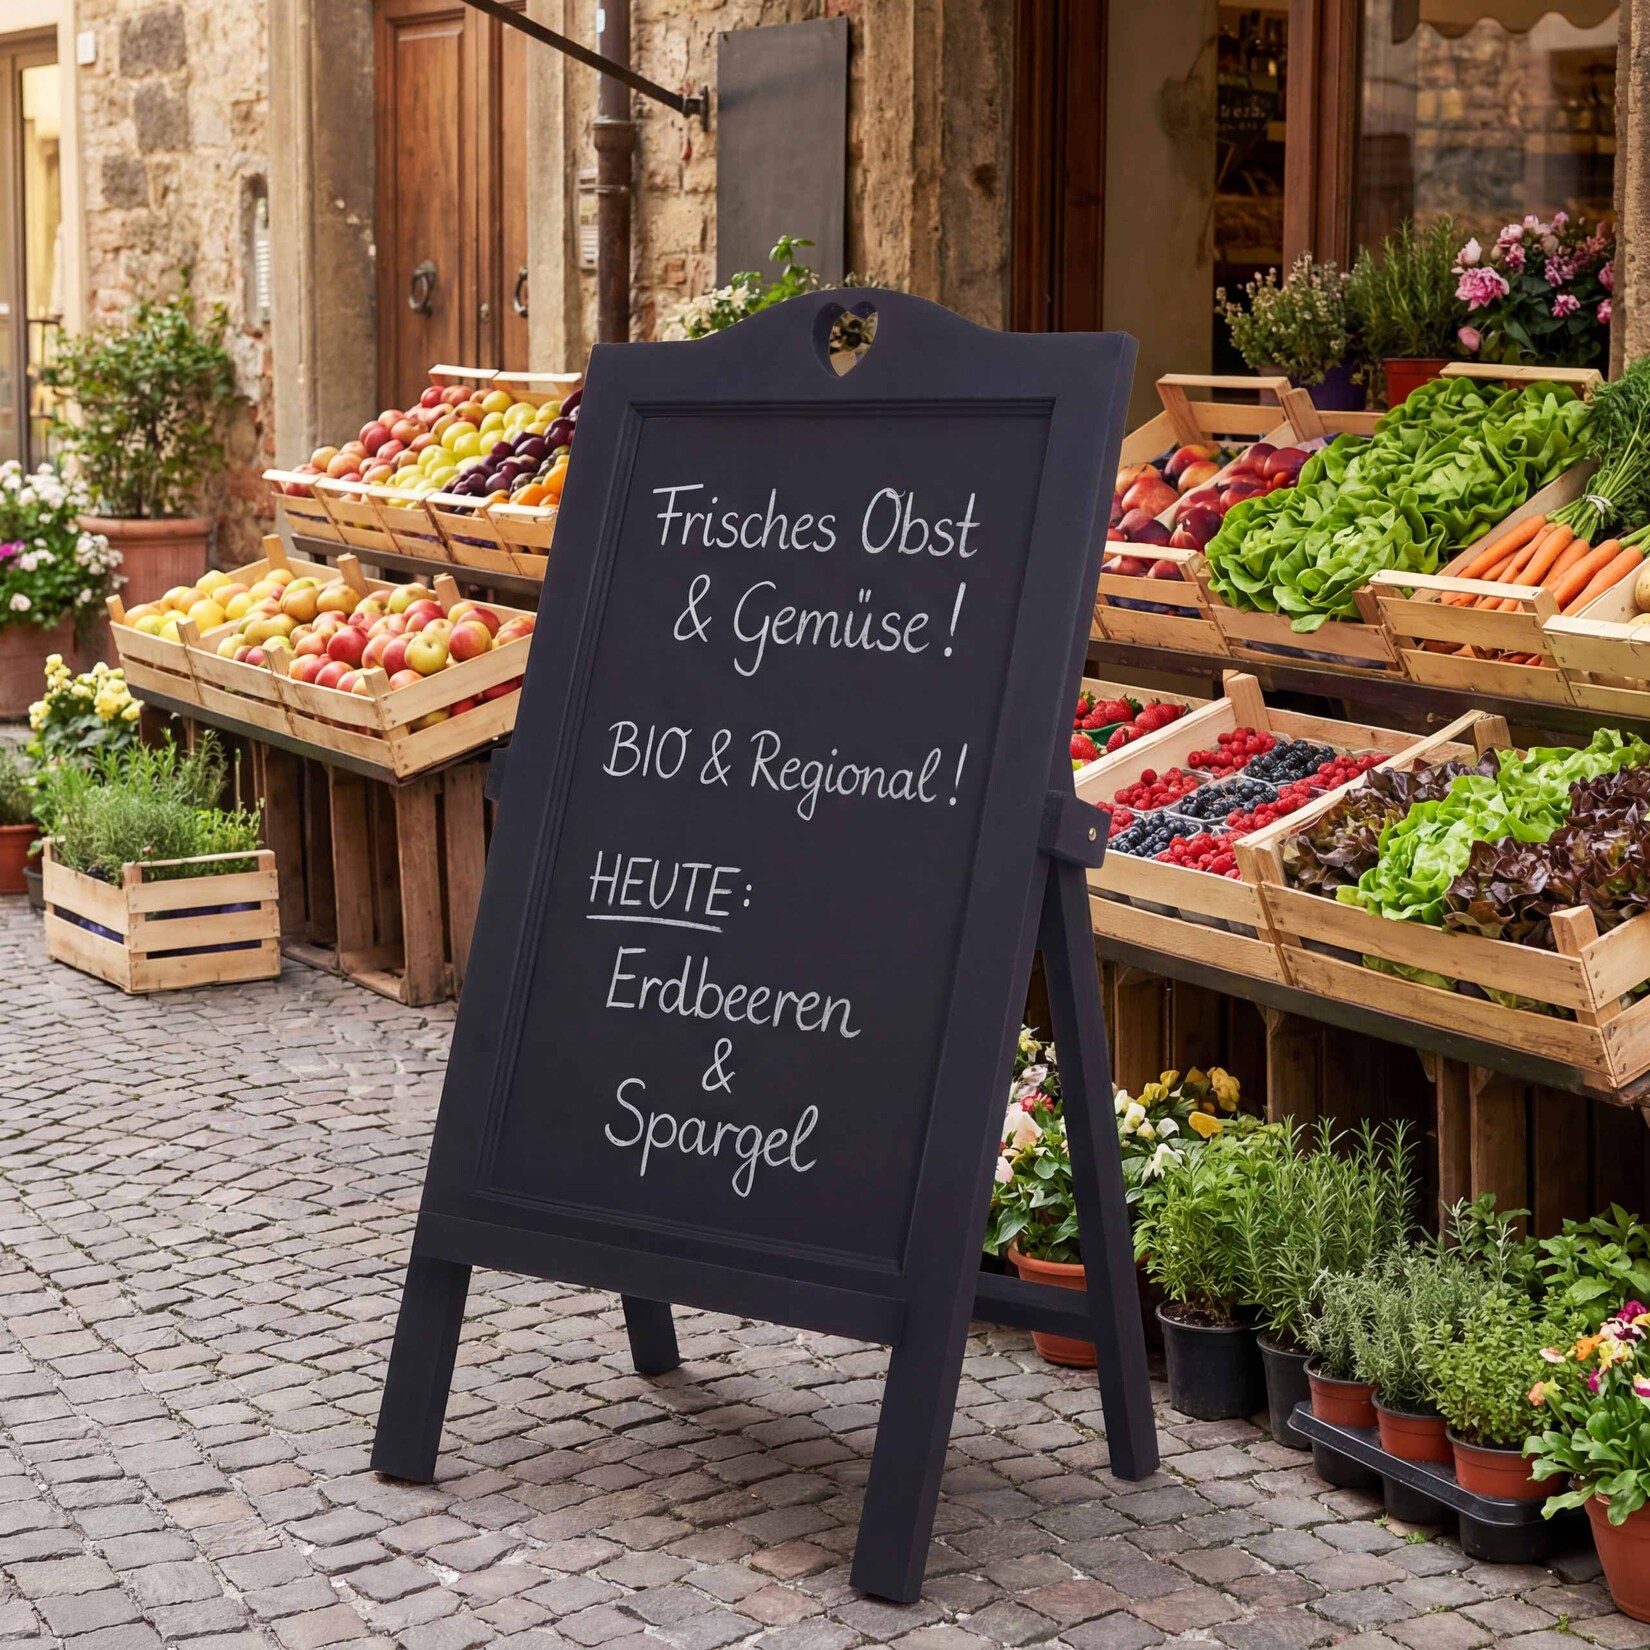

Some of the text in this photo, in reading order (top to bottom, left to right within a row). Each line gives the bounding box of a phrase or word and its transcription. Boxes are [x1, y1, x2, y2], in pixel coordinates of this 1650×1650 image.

[652, 483, 981, 558] Frisches Obst
[673, 573, 712, 643] &
[602, 719, 693, 779] BIO
[699, 728, 732, 787] &
[588, 850, 753, 918] HEUTE:
[605, 945, 861, 1039] Erdbeeren
[701, 1037, 736, 1094] &
[604, 1077, 819, 1198] Spargel
